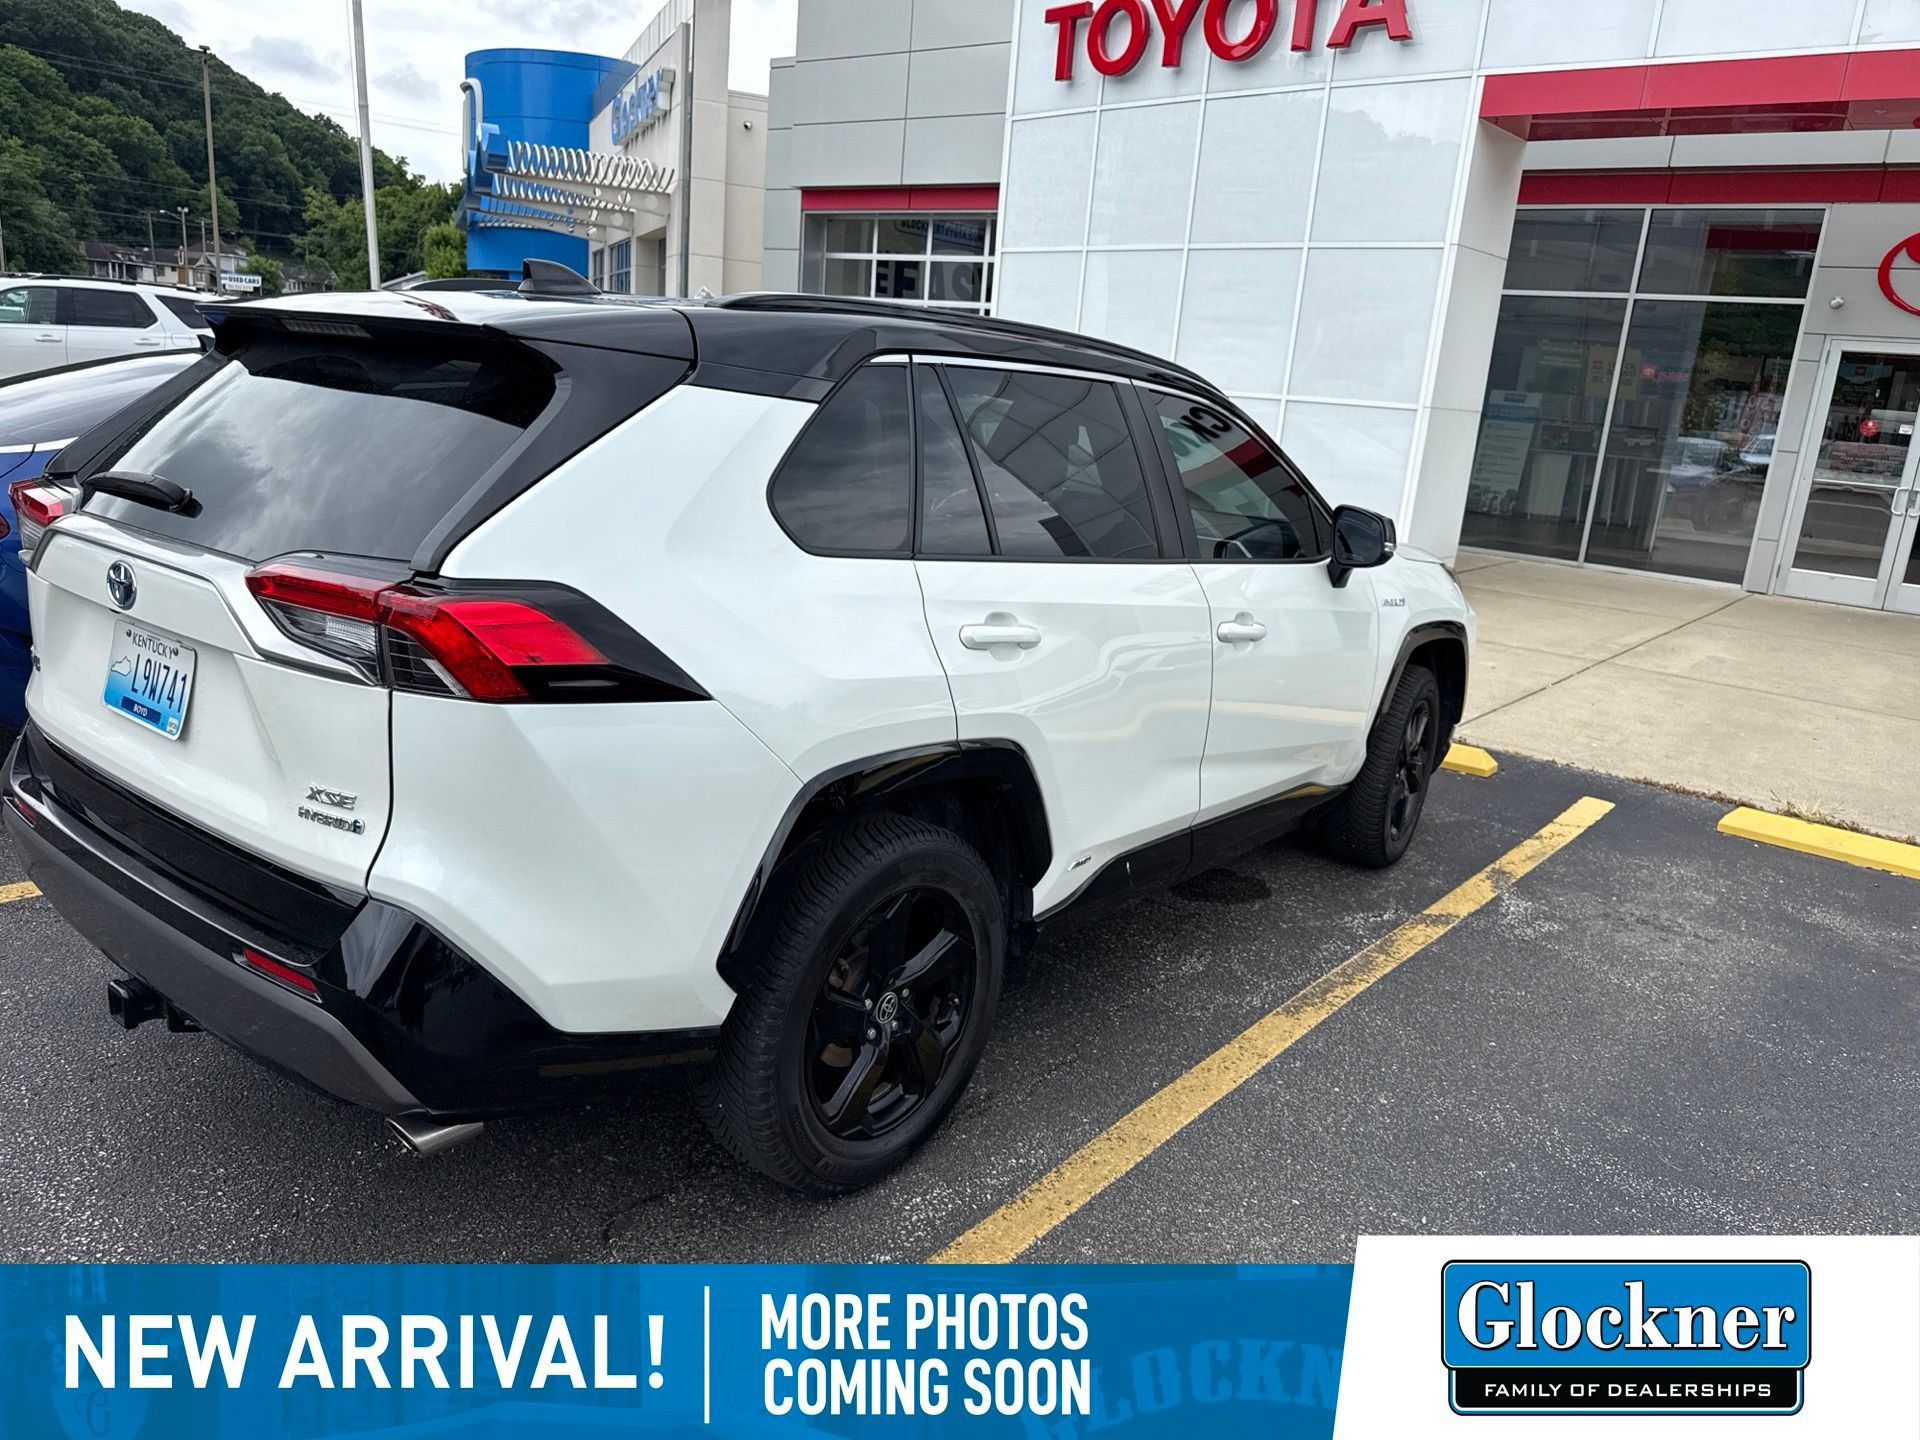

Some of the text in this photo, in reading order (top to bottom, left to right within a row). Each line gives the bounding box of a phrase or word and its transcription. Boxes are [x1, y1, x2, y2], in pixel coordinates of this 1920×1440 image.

[1045, 0, 1412, 82] TOYOTA
[901, 219, 985, 243] GLOCKRTOYOTA.COM
[228, 275, 260, 285] USED CARS
[132, 632, 173, 659] KENTUCKY
[131, 653, 187, 713] L9W741
[133, 703, 148, 717] BOYD
[305, 785, 357, 811] XSE
